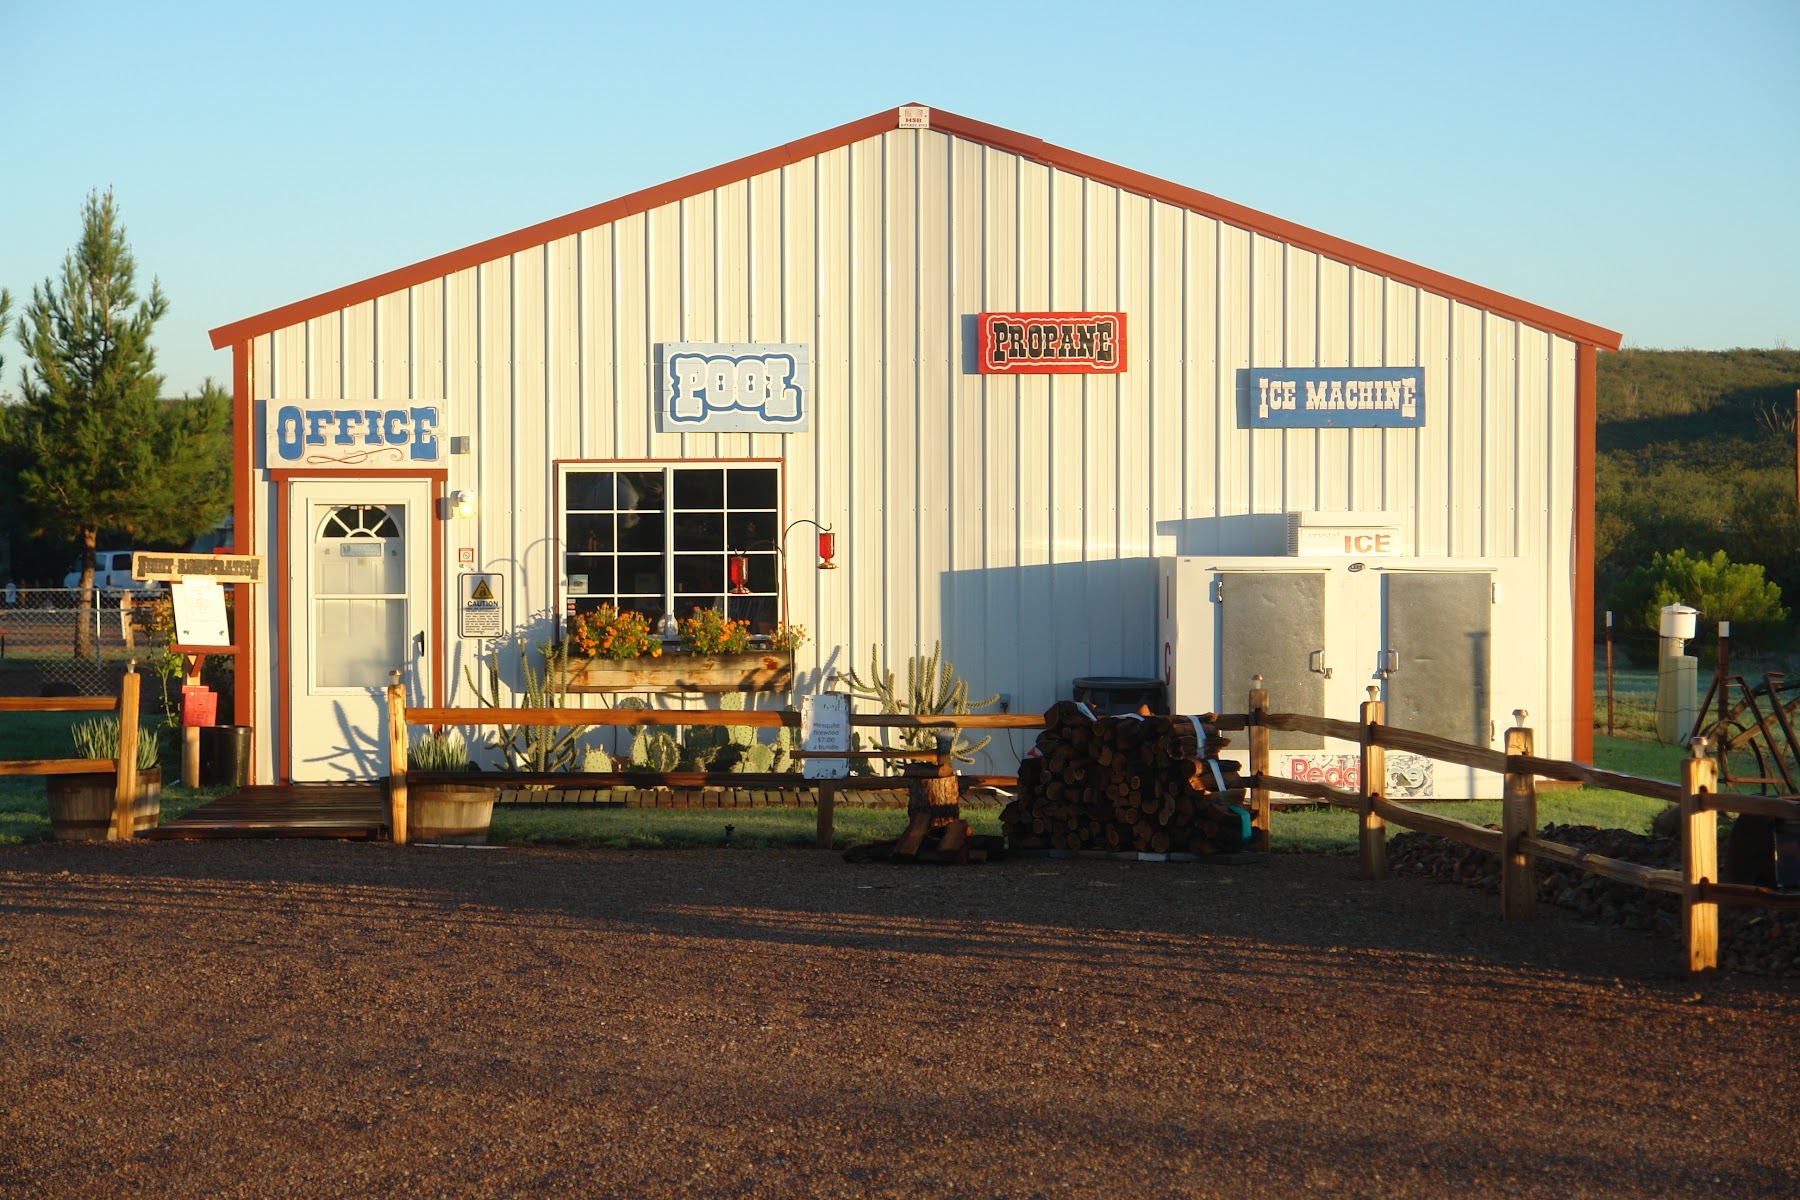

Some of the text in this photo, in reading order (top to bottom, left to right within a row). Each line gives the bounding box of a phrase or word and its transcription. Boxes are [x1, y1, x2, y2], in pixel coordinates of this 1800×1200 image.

[992, 321, 1113, 363] PROPANE
[672, 355, 799, 419] POOL
[1259, 377, 1416, 418] ICE MACHINE
[277, 405, 439, 461] OFFICE
[1344, 534, 1392, 553] ICE
[1291, 758, 1361, 790] Redd
